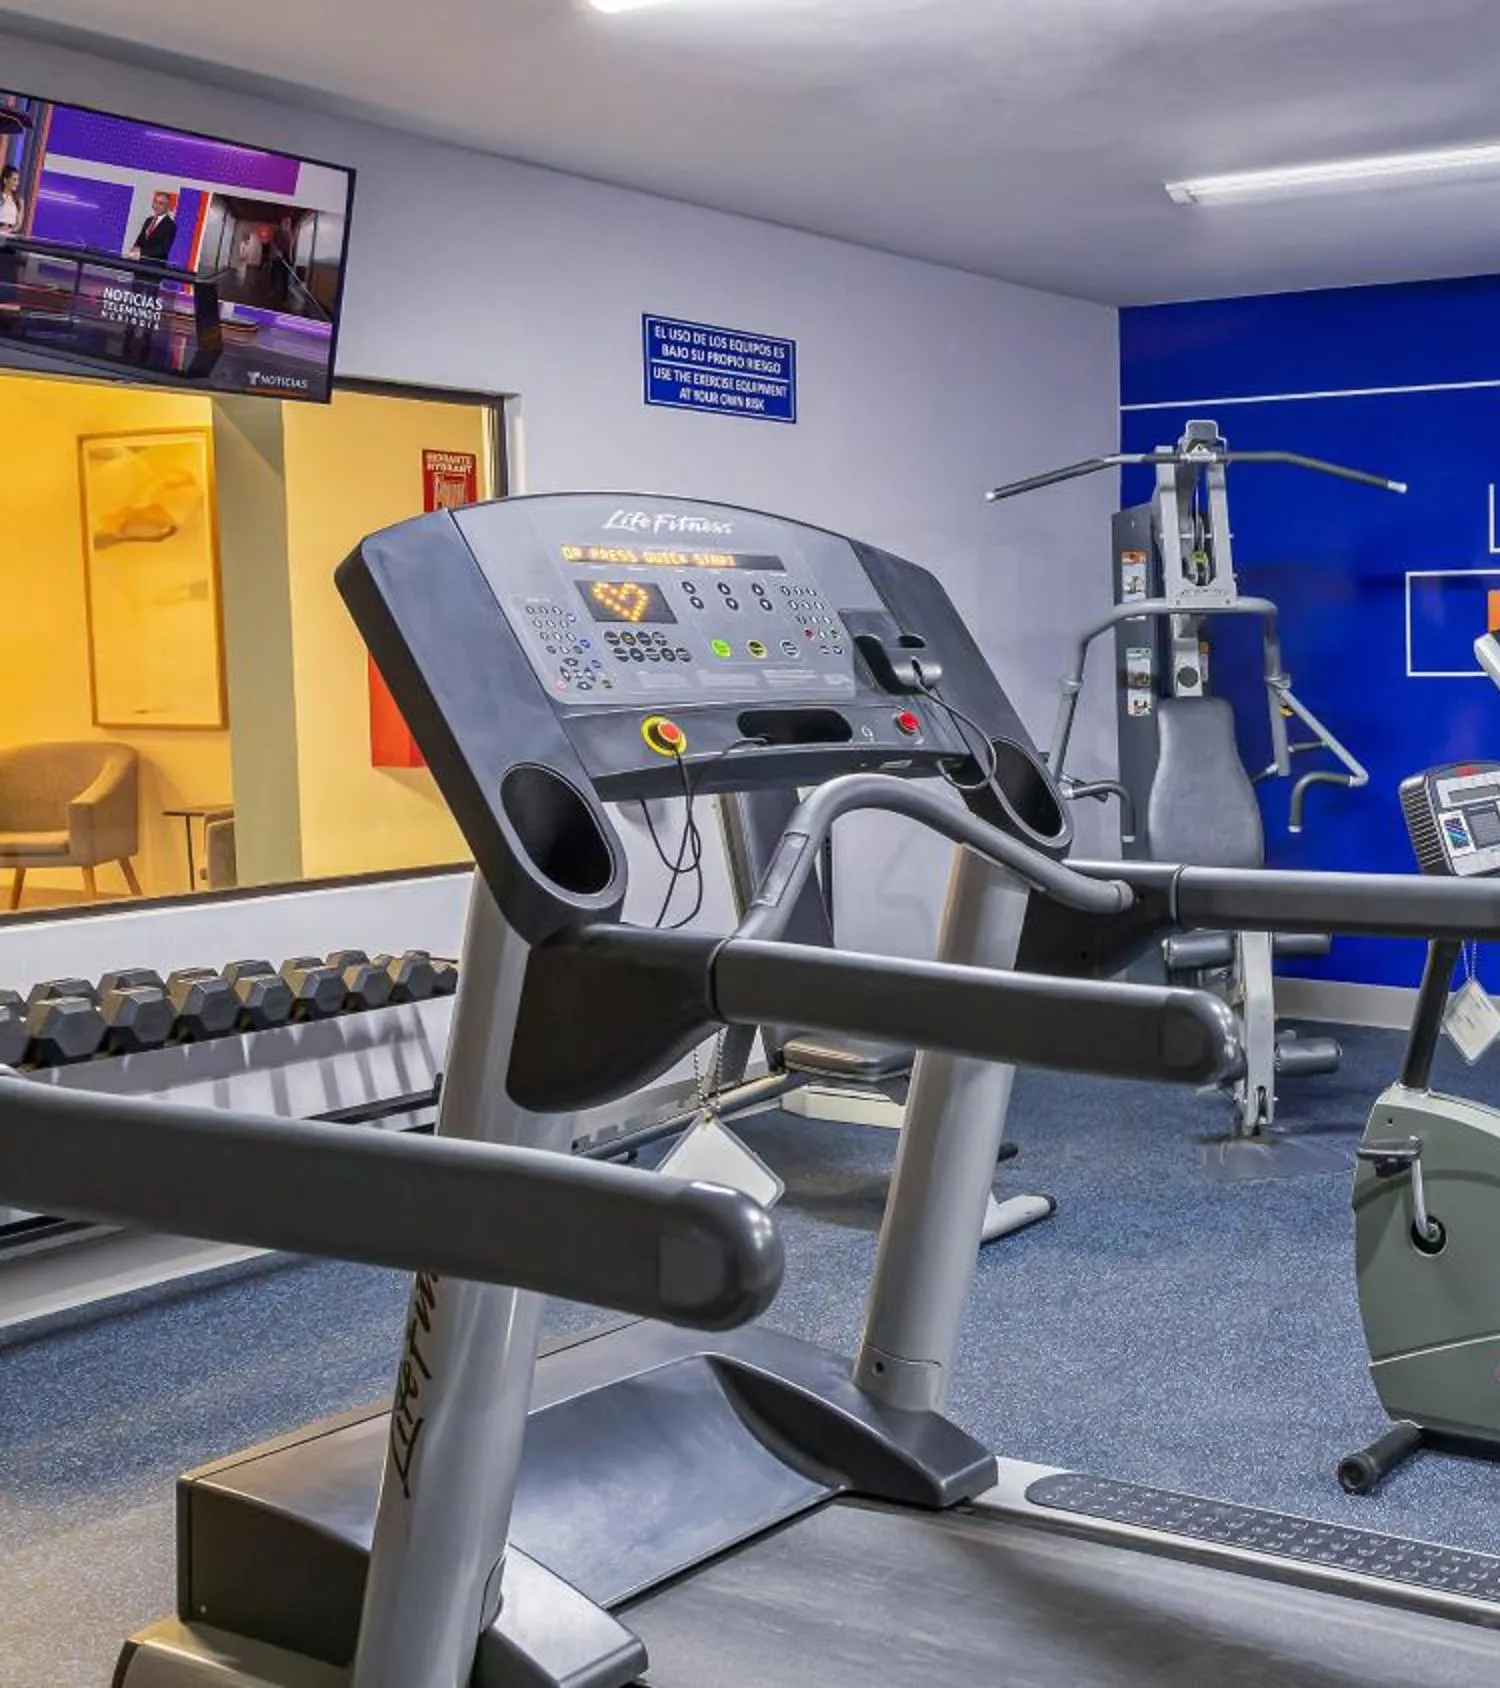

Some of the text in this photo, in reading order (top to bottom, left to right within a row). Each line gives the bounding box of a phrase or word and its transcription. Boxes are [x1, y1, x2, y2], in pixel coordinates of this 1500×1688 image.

[103, 287, 163, 310] NOTICIAS
[655, 326, 785, 359] EL USO DE LOS EQUIPOS ES
[662, 344, 781, 374] BAJO SU PROPIO RIESGO
[261, 374, 309, 389] NOTICIAS
[654, 367, 788, 397] USE THE EXERCISE EQUIPMENT
[679, 387, 765, 411] AT YOUR OWN RISK
[603, 509, 733, 534] Life Fitness
[591, 548, 638, 563] PRESS
